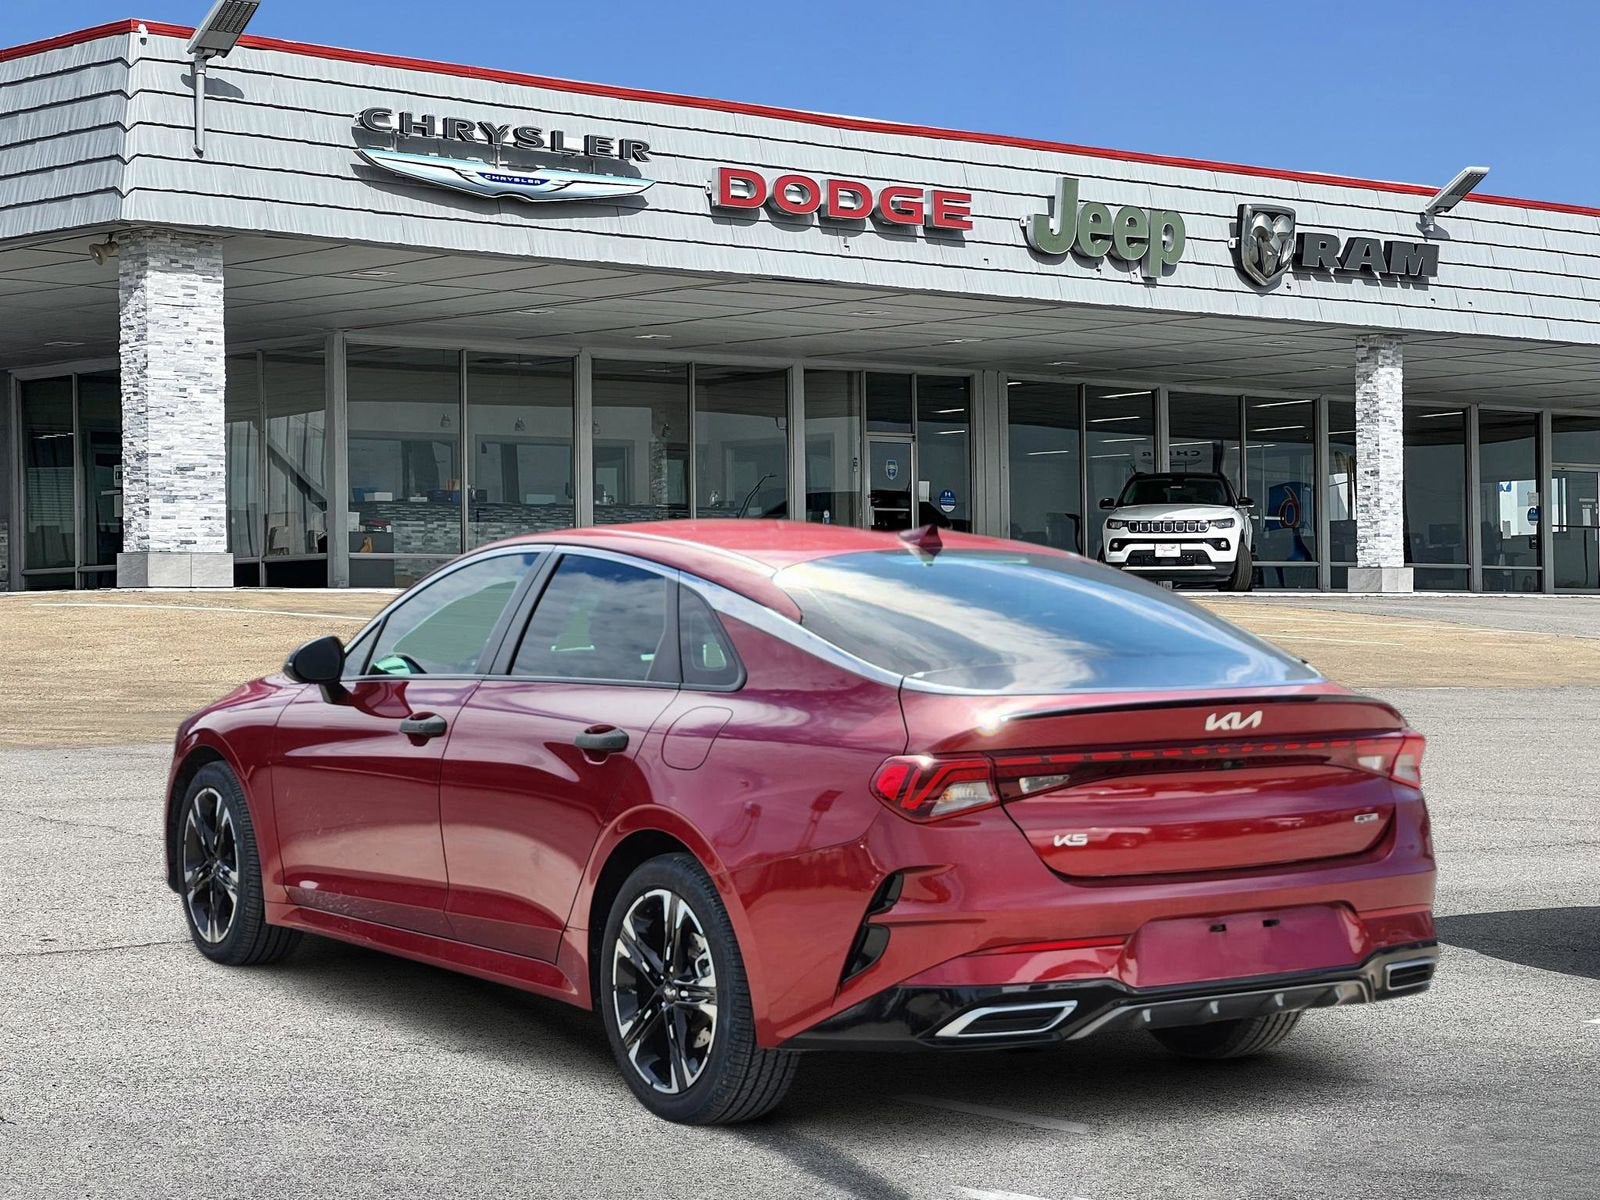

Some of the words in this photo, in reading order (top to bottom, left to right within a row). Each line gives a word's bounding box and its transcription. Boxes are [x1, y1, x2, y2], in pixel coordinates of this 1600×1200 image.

[358, 107, 651, 162] CHRYSLER
[484, 174, 541, 185] CHRYSLER
[712, 167, 974, 230] DODGE
[1028, 177, 1186, 278] Jeep
[1301, 232, 1440, 278] RAM
[1053, 833, 1089, 847] K5
